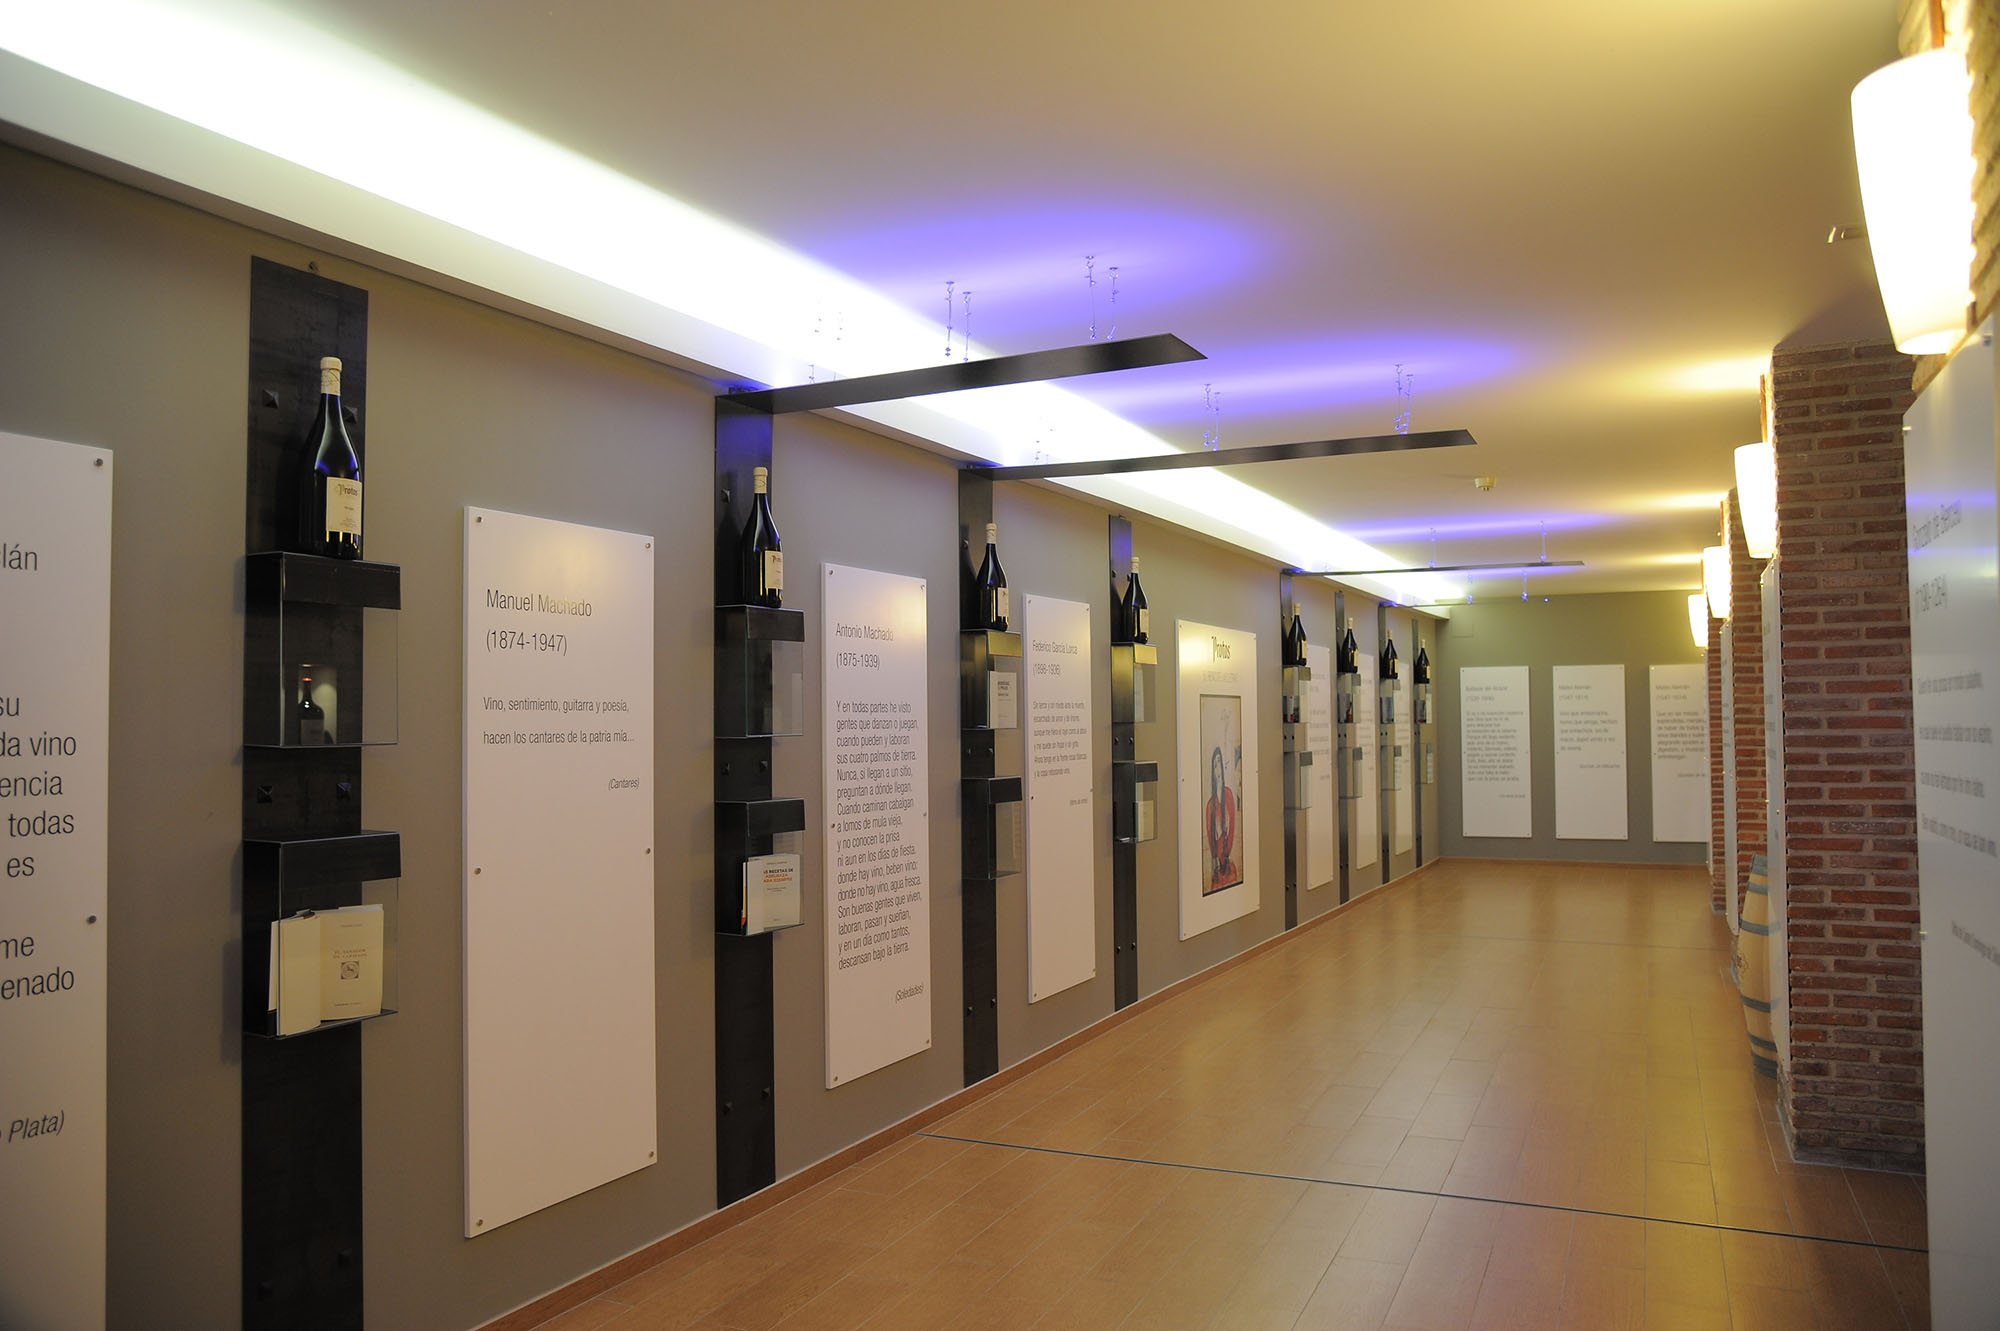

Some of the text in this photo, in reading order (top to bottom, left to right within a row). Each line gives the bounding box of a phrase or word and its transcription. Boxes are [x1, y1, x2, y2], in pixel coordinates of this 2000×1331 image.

[0, 543, 38, 571] lán
[486, 588, 592, 618] Manuel Machado
[836, 623, 894, 641] Antonio Machado
[486, 629, 568, 656] (1874-1947)
[836, 652, 880, 670] (1875-1939)
[0, 697, 20, 717] u
[483, 697, 630, 714] Vino, sentimiento, guitarra y poesía,
[836, 700, 912, 715] Y en todas partes he visto
[836, 719, 857, 732] gentes
[859, 720, 870, 732] que
[872, 718, 892, 730] danzan
[30, 732, 77, 756] vino
[484, 729, 635, 745] hacen los cantares de la patria mía...
[836, 735, 860, 747] cuando
[860, 735, 883, 748] pueden
[836, 754, 848, 764] sus
[850, 752, 869, 764] cuatro
[870, 750, 891, 764] palmos
[892, 750, 900, 761] de
[608, 777, 640, 791] (Cantares)
[860, 768, 866, 780] si
[886, 768, 890, 778] a
[0, 771, 63, 798] encia
[870, 786, 874, 796] a
[8, 811, 75, 838] todas
[837, 824, 842, 832] a
[842, 820, 862, 832] lomos
[862, 818, 871, 830] de
[872, 816, 887, 828] mula
[837, 840, 841, 853] y
[842, 839, 851, 848] no
[878, 832, 884, 844] la
[6, 856, 35, 878] es
[838, 854, 844, 867] ni
[858, 852, 866, 864] en
[868, 850, 876, 862] los
[890, 847, 898, 858] de
[838, 870, 858, 884] donde
[858, 869, 869, 882] hay
[886, 862, 904, 876] beben
[838, 887, 857, 902] donde
[857, 887, 864, 898] no
[866, 884, 876, 898] hay
[890, 879, 904, 893] agua
[838, 905, 850, 918] Son
[852, 901, 874, 916] buenas
[874, 897, 894, 913] gentes
[895, 894, 906, 908] que
[864, 916, 883, 931] pasan
[884, 916, 888, 928] y
[838, 942, 842, 956] y
[844, 940, 852, 952] en
[853, 938, 862, 949] un
[874, 931, 890, 943] como
[838, 952, 872, 970] descansan
[872, 946, 886, 962] bajo
[886, 945, 892, 956] la
[1, 966, 75, 1000] enado
[8, 1109, 65, 1144] Plata)
